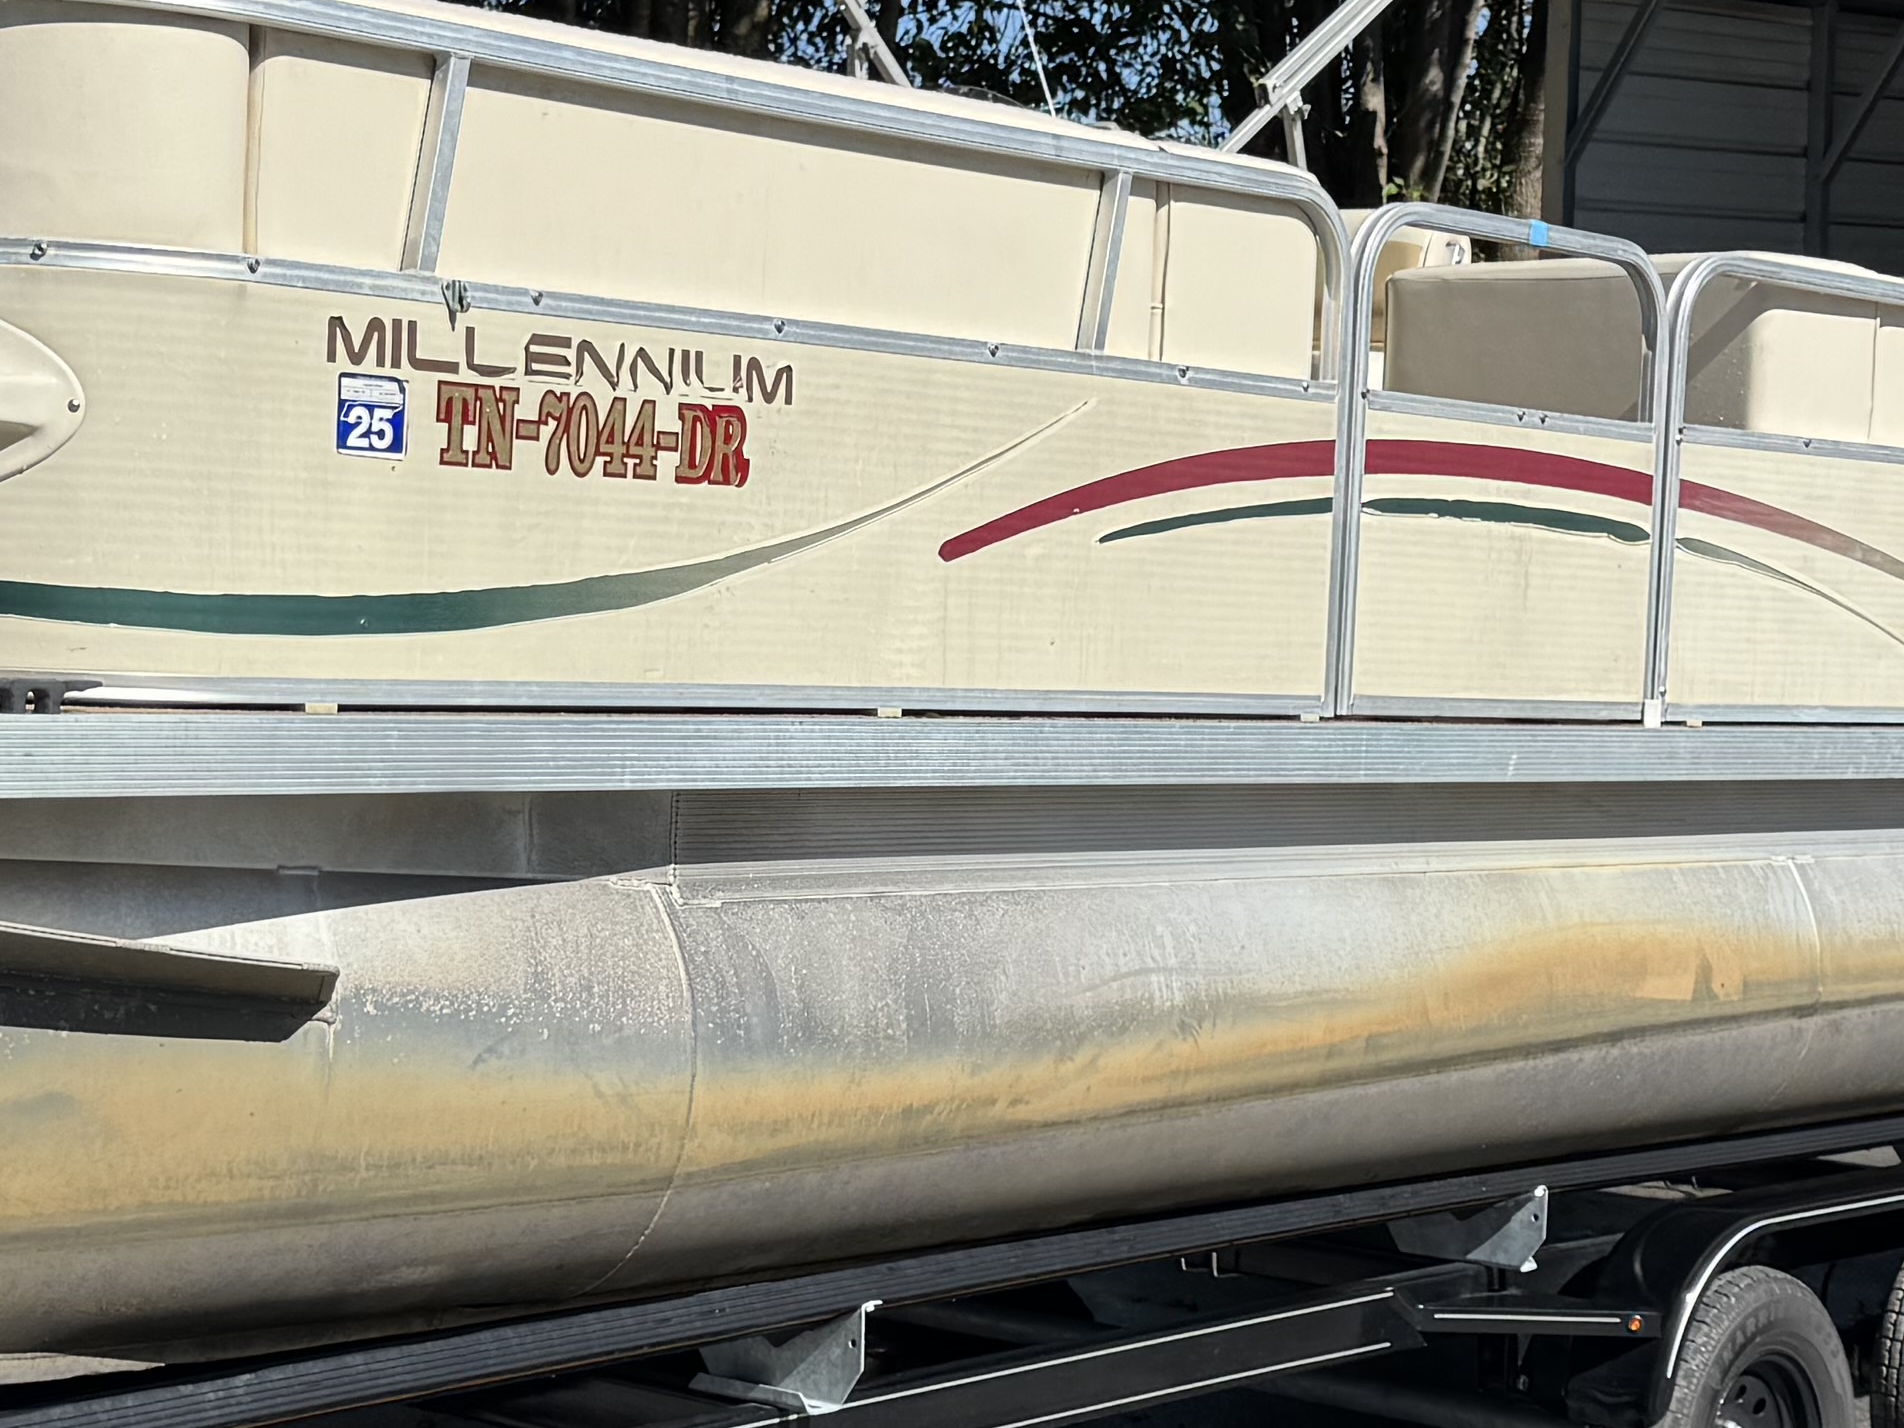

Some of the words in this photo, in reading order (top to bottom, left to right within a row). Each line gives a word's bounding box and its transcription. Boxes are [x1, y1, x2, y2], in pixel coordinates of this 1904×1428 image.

[327, 316, 794, 405] MILLENNIUM
[346, 405, 394, 450] 25
[436, 380, 750, 487] TN-7044-DR
